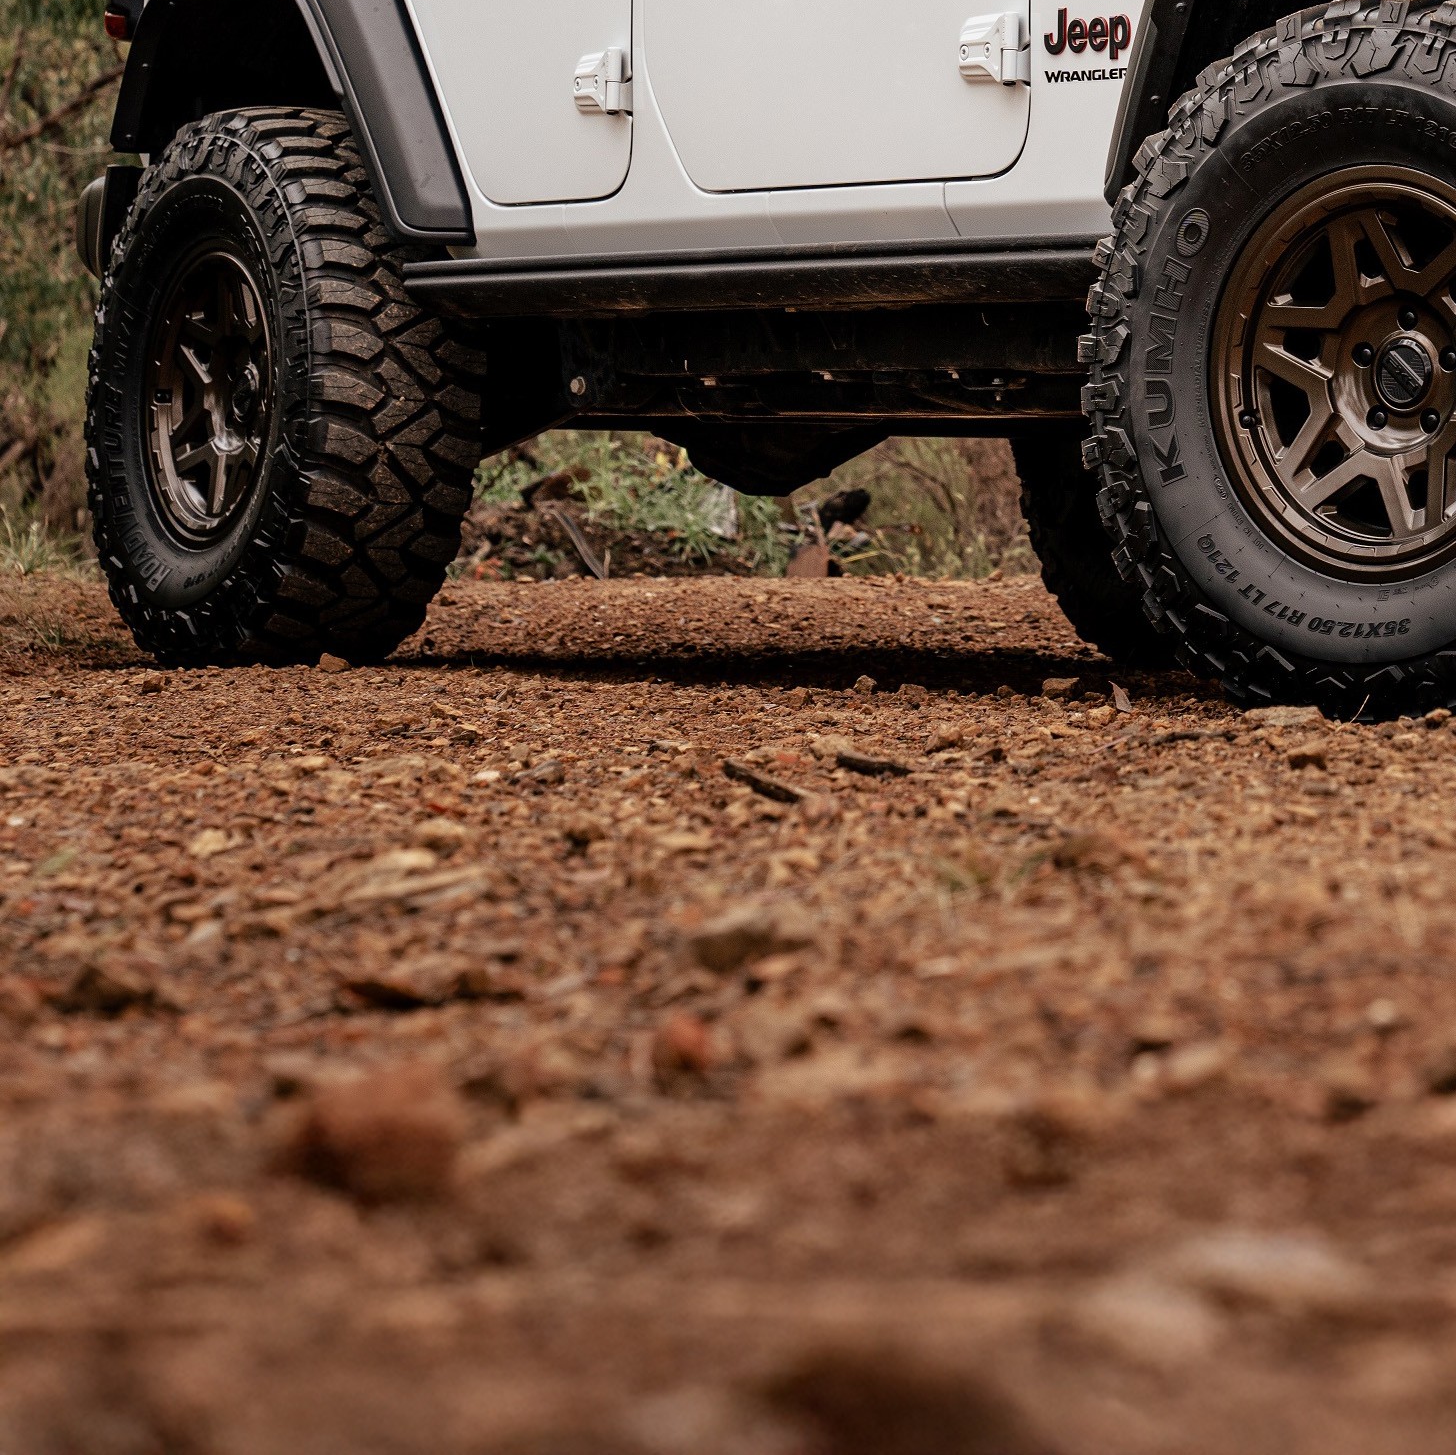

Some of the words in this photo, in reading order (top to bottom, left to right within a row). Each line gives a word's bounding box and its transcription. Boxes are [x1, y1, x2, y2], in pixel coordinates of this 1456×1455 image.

[1043, 7, 1132, 60] Jeep
[1044, 67, 1127, 83] WRANGLER
[1143, 207, 1211, 487] KUMHO
[1196, 531, 1241, 585] 121Q
[1236, 582, 1268, 607] LT
[1262, 603, 1309, 628] R17
[1306, 615, 1412, 639] 35X12.50
